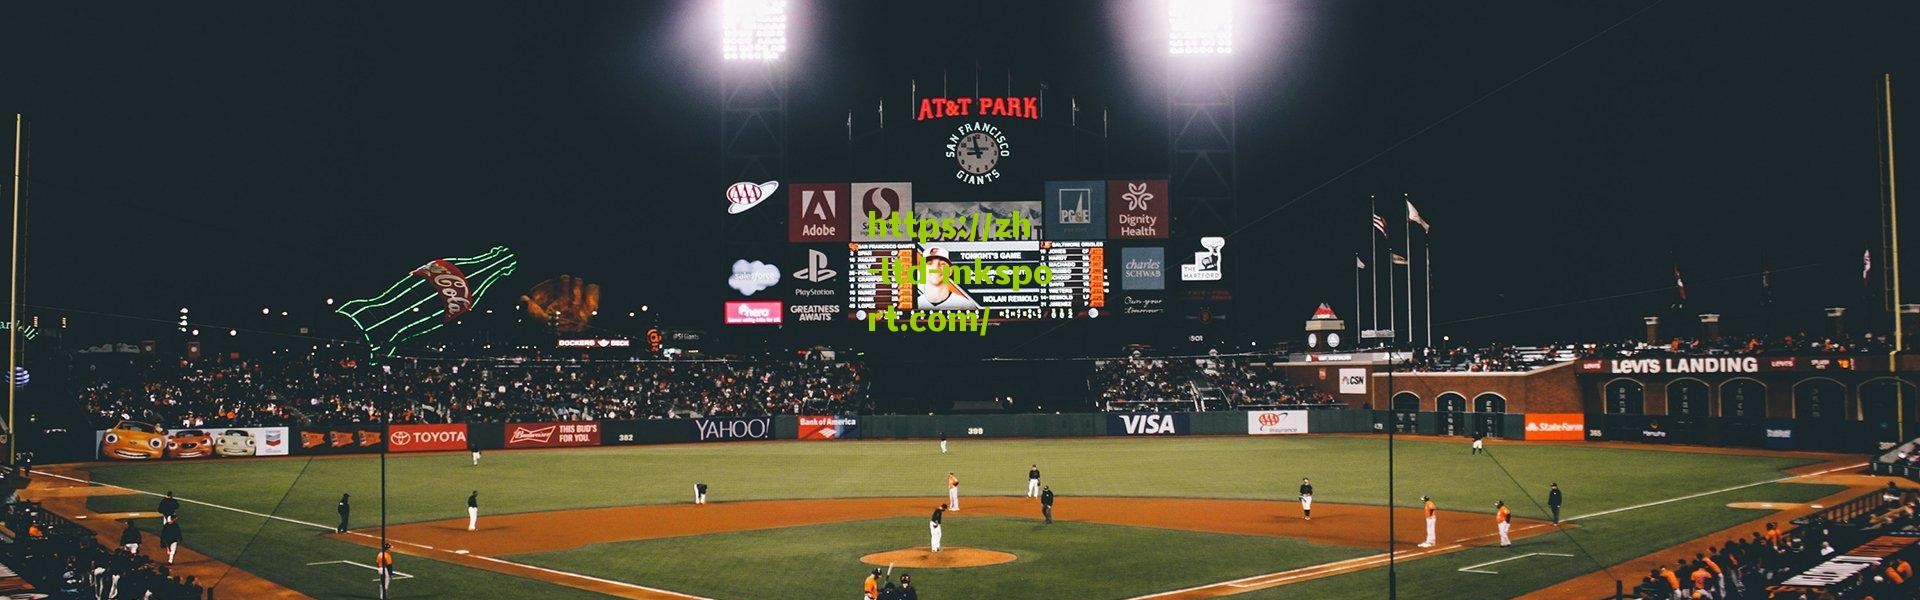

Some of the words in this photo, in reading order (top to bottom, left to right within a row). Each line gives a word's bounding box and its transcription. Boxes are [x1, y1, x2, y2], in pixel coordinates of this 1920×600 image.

[918, 98, 972, 120] AT&T
[979, 97, 1038, 119] PARK
[946, 134, 959, 158] SAN
[958, 122, 1010, 157] FRANCISCO
[956, 169, 1000, 185] GIANTS
[1061, 209, 1089, 223] PG&E
[1119, 214, 1157, 227] Dignity
[802, 225, 836, 236] Adobe
[1121, 227, 1156, 236] Health
[960, 252, 999, 260] TONIGHT'S
[1125, 259, 1160, 270] charles
[1125, 270, 1161, 278] SCHWAB
[434, 274, 471, 314] Cola
[795, 288, 834, 297] PlayStation
[790, 305, 840, 313] GREATNESS
[799, 313, 832, 321] AWAITS
[1665, 357, 1758, 373] LANDING
[1349, 375, 1365, 386] CSN
[800, 417, 819, 426] Bank
[819, 417, 825, 426] of
[825, 417, 856, 426] America
[1119, 414, 1175, 434] VISA
[514, 428, 551, 439] Budweiser
[559, 424, 575, 433] THIS
[576, 424, 598, 433] BUD'S
[695, 418, 771, 441] YAHOO!
[412, 431, 467, 443] TOYOTA
[559, 434, 573, 443] FOR
[574, 434, 590, 442] YOU.
